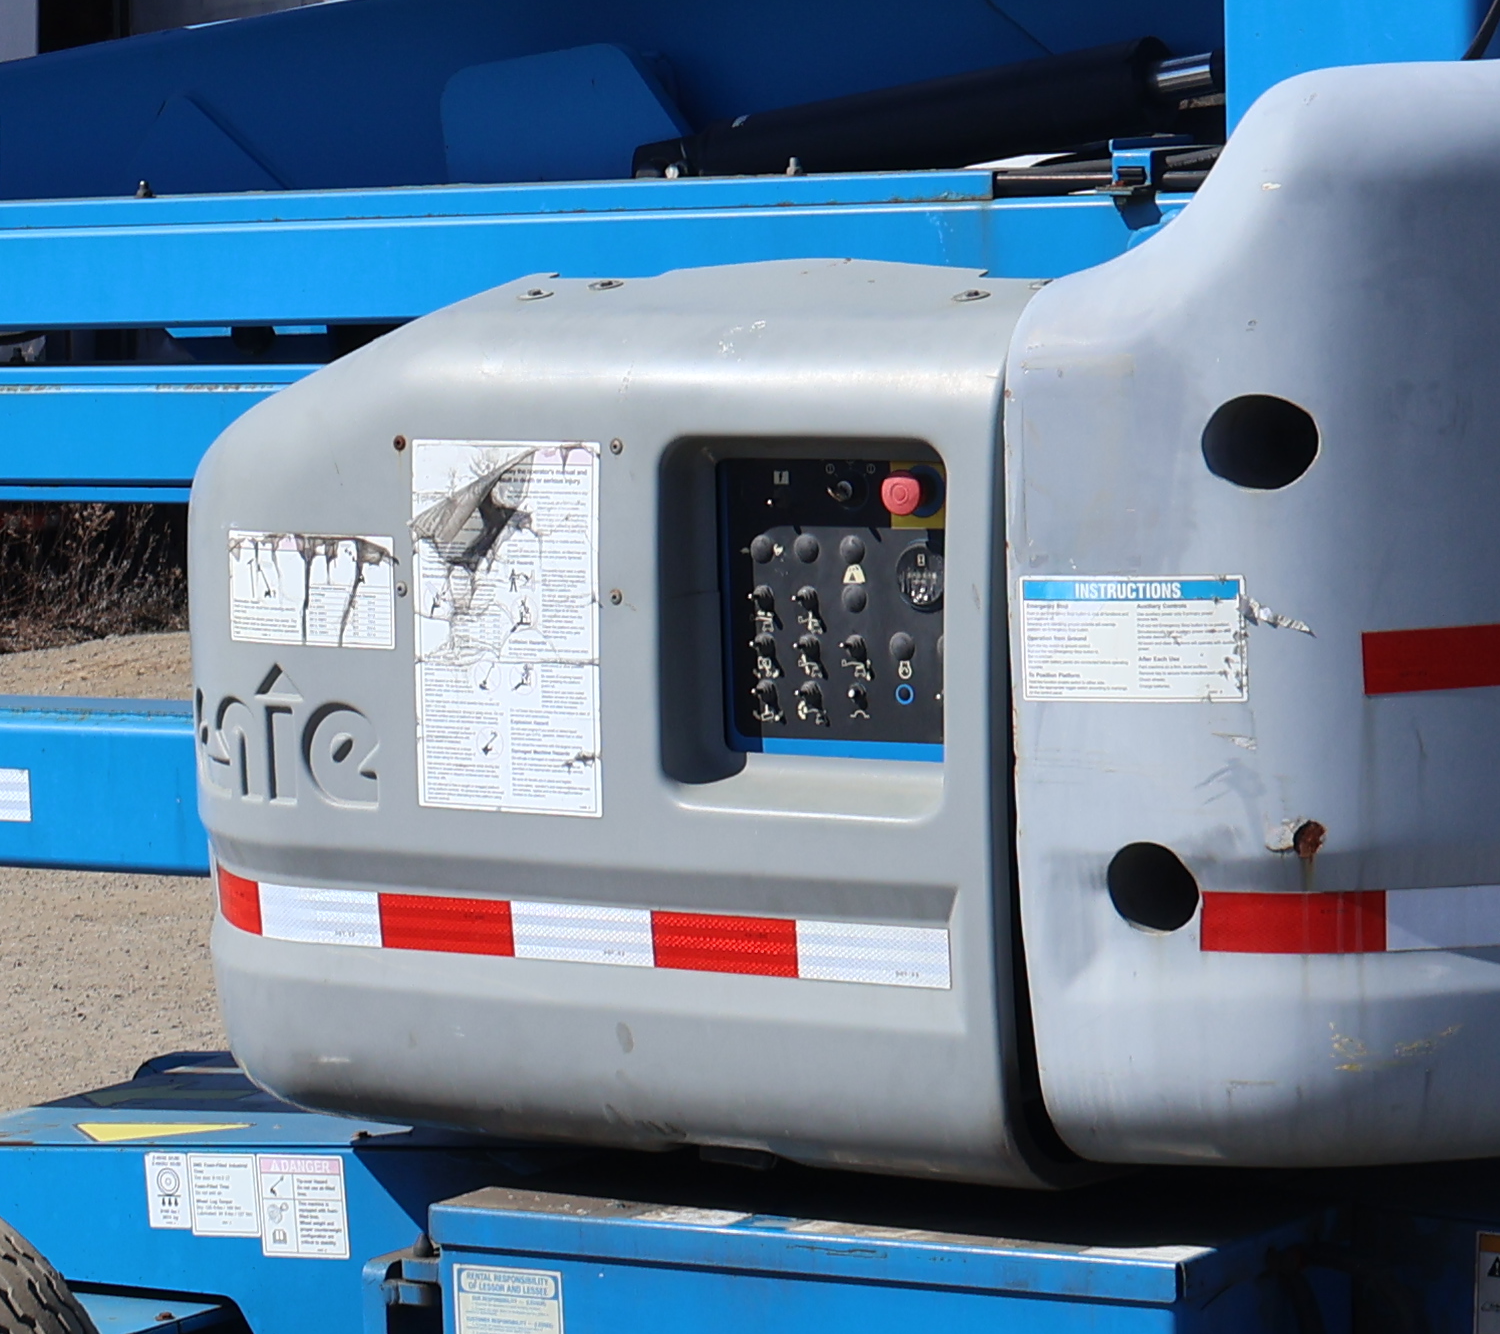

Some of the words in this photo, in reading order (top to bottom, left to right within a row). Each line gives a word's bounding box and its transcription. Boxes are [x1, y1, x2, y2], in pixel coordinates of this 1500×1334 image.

[1075, 582, 1181, 599] INSTRUCTIONS
[281, 1159, 330, 1173] DANGER
[467, 1272, 492, 1281] RENTAL
[494, 1273, 548, 1286] RESPONSIBILITY
[479, 1283, 505, 1292] LESSOR
[507, 1285, 521, 1293] AND
[523, 1286, 548, 1296] LESSEE
